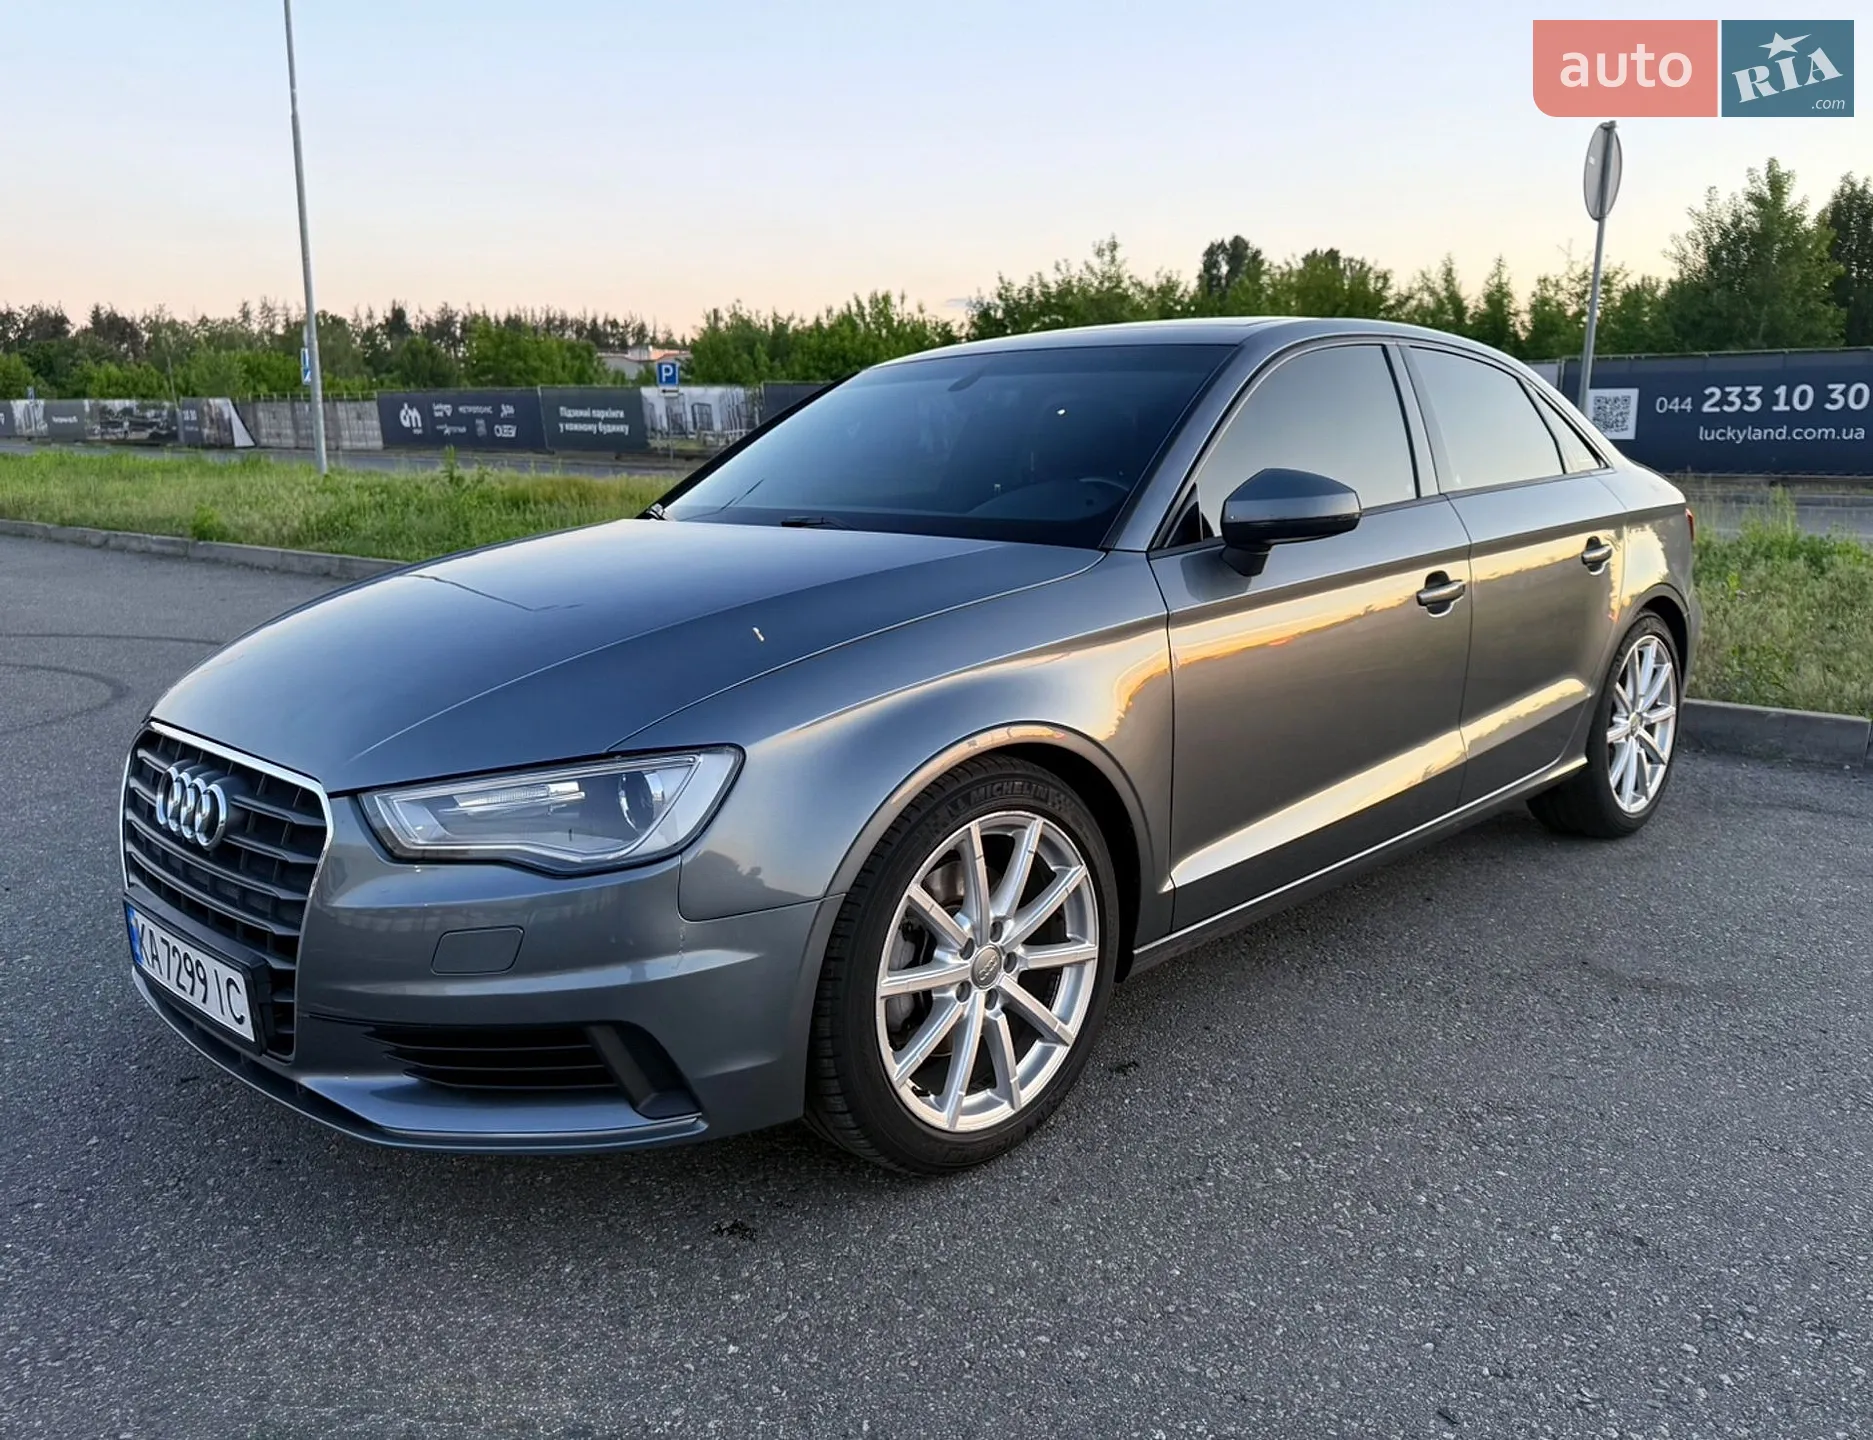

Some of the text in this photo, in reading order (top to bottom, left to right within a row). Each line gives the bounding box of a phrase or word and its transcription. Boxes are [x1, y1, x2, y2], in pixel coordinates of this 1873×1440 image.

[661, 364, 674, 383] P
[1655, 383, 1871, 413] 044 233 10 30
[1699, 425, 1866, 443] luckyland.com.ua
[970, 781, 1048, 803] MICHELIN
